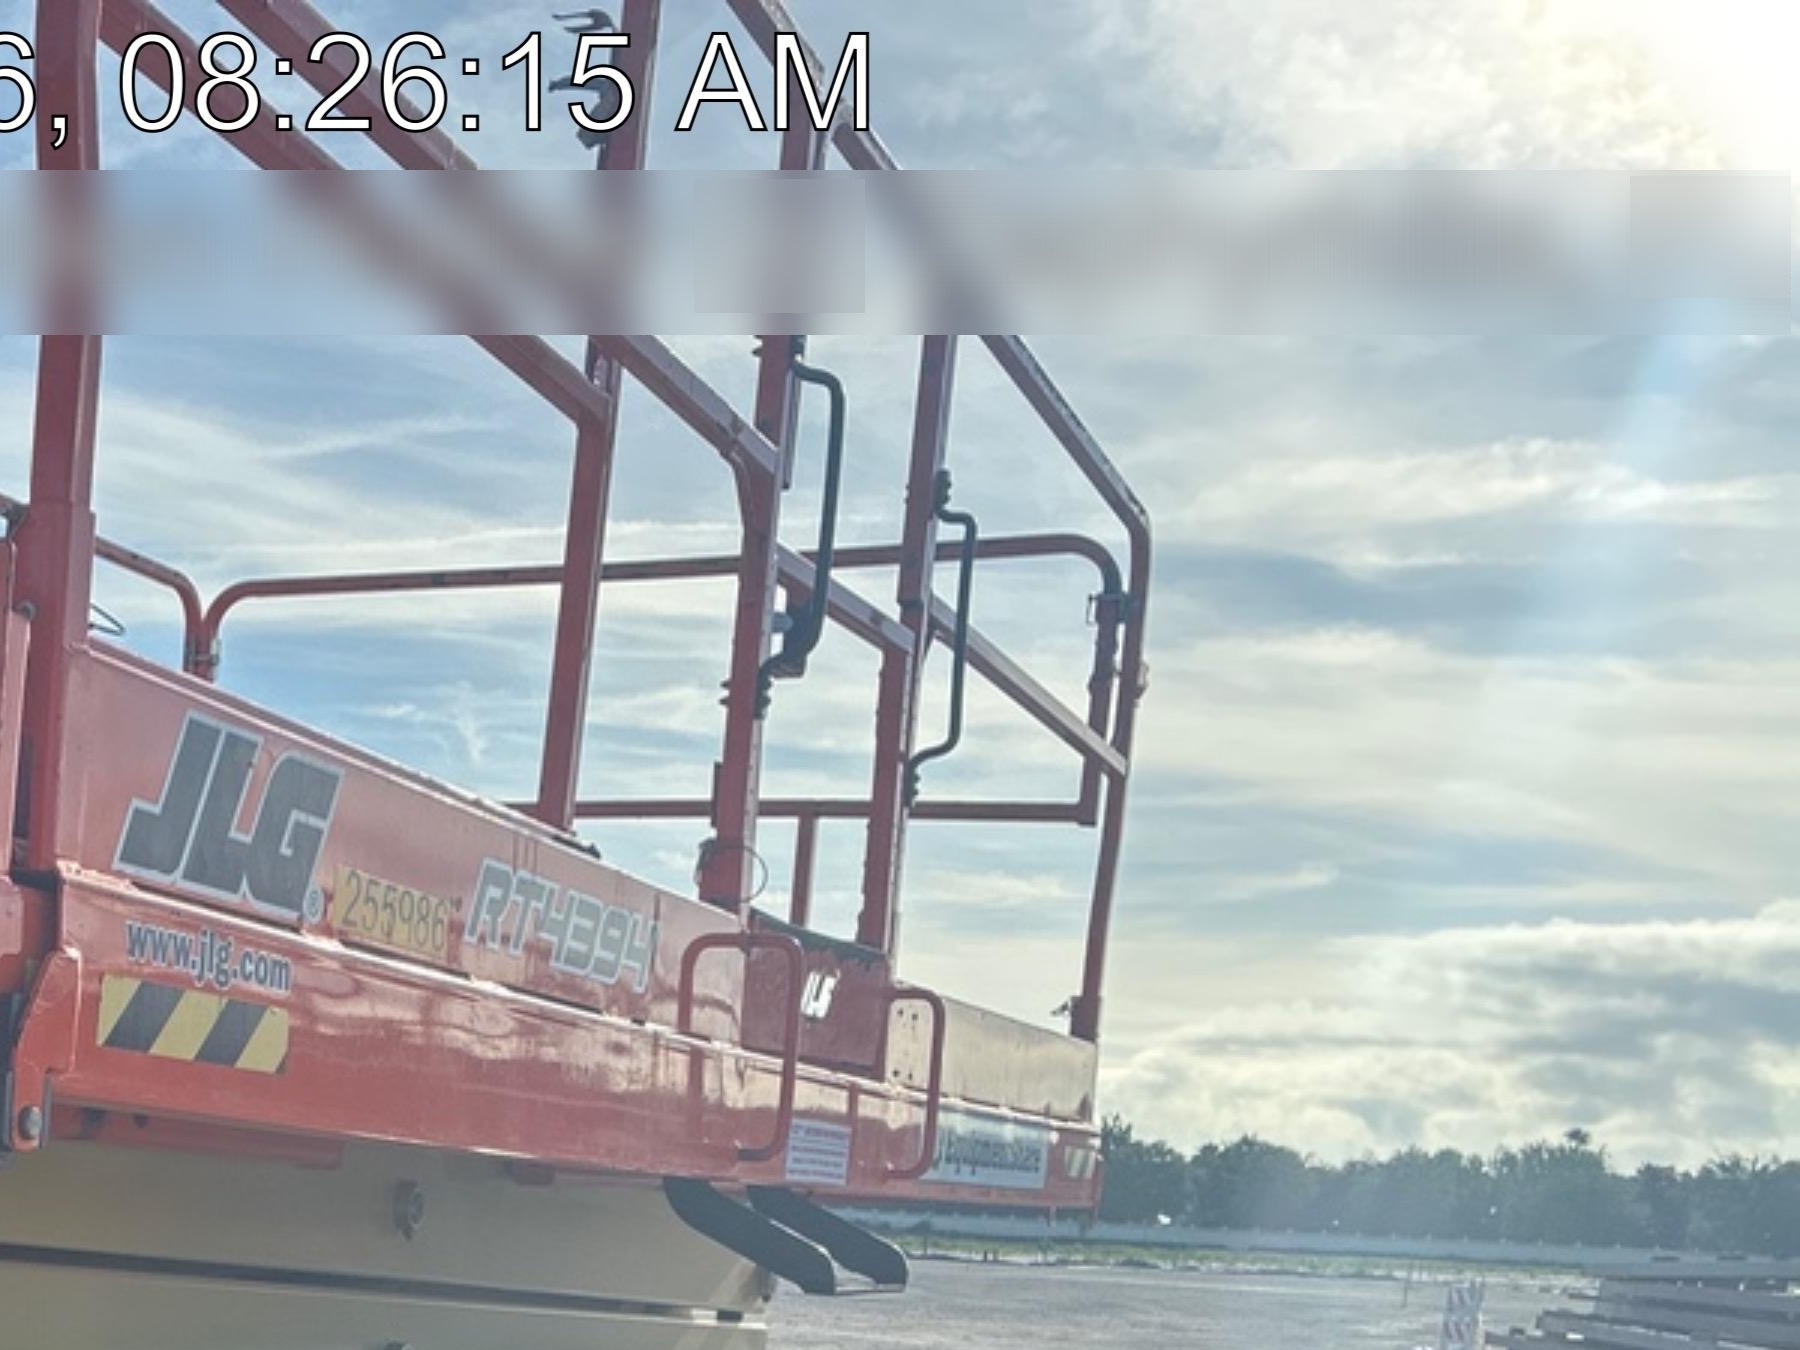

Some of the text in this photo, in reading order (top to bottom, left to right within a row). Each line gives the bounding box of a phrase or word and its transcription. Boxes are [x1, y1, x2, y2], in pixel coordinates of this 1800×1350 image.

[111, 710, 345, 920] JLG
[341, 868, 447, 952] 255986
[126, 920, 292, 996] www.jlg.com
